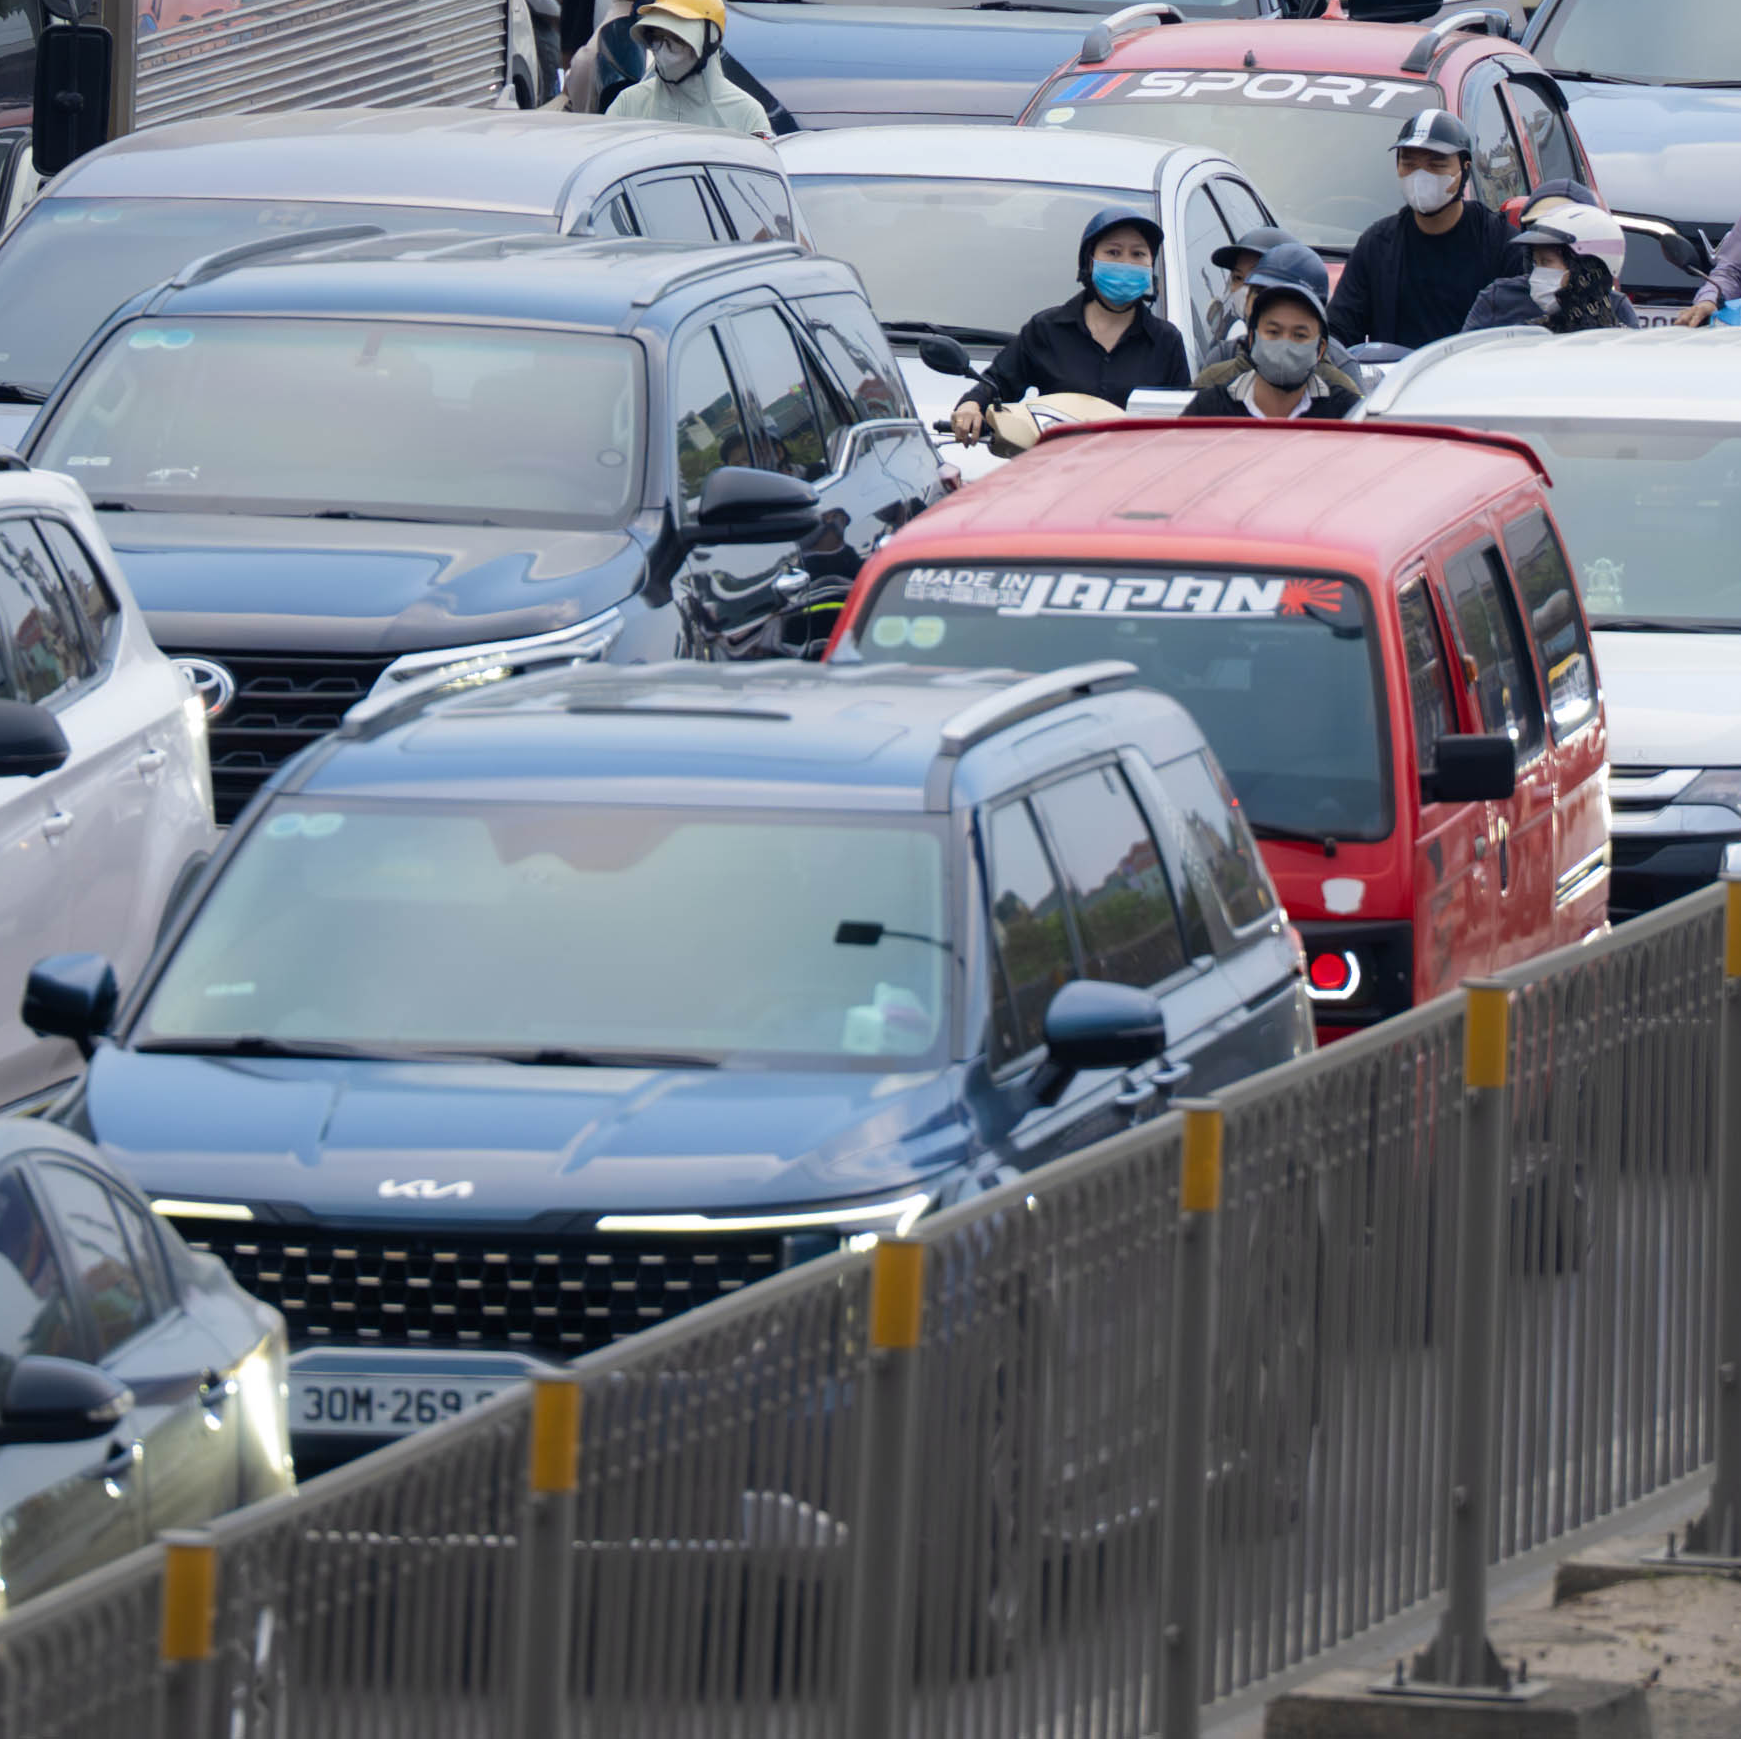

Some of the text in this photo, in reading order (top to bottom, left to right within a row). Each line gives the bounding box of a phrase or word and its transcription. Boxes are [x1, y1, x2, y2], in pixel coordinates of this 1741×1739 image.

[1125, 70, 1425, 110] SPORT
[907, 568, 1032, 591] MADE IN
[998, 572, 1286, 618] JAPAN
